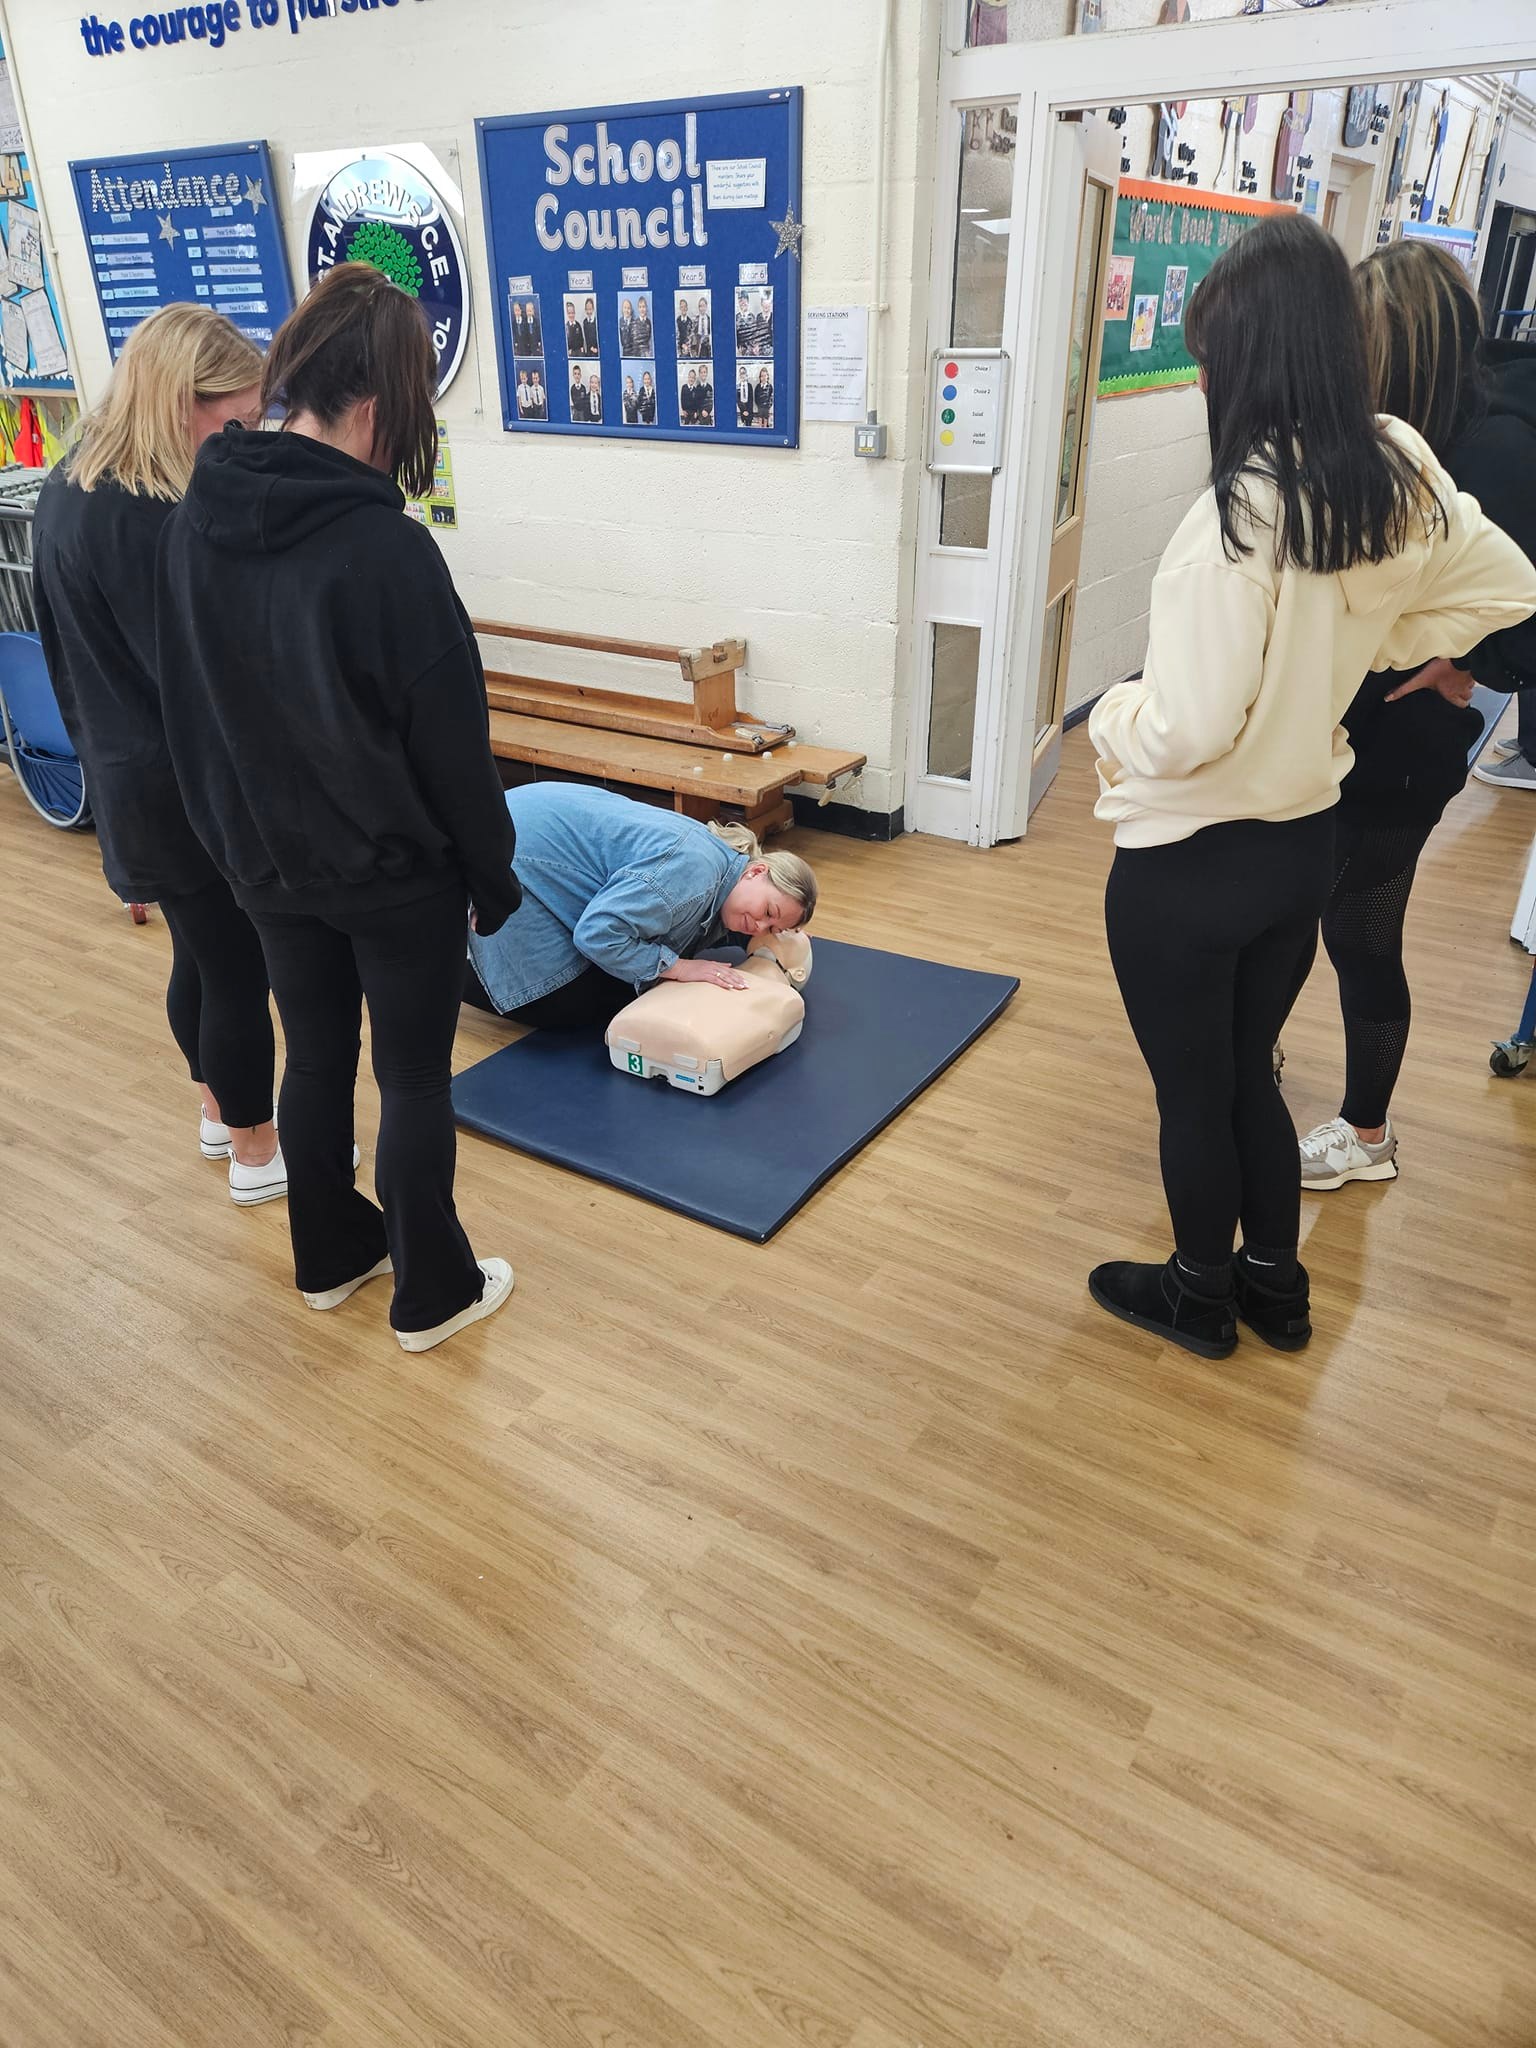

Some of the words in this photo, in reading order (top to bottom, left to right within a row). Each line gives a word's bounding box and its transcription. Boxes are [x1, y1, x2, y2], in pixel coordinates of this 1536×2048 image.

[80, 15, 125, 56] the
[129, 0, 241, 48] courage
[247, 0, 279, 29] to
[543, 112, 701, 186] School
[90, 160, 242, 213] Attendance
[534, 183, 708, 251] Council
[1129, 201, 1176, 245] World
[1180, 207, 1213, 247] Book
[322, 179, 424, 249] ANDREW'S
[420, 226, 450, 287] C.E.
[571, 278, 585, 286] Year
[587, 277, 591, 285] 3
[624, 274, 639, 282] Year
[641, 273, 645, 281] 4
[681, 272, 697, 281] Year
[698, 271, 703, 280] 5
[760, 270, 765, 279] 6
[526, 281, 530, 289] 2
[827, 311, 849, 319] STATIONS
[629, 1054, 641, 1074] 3
